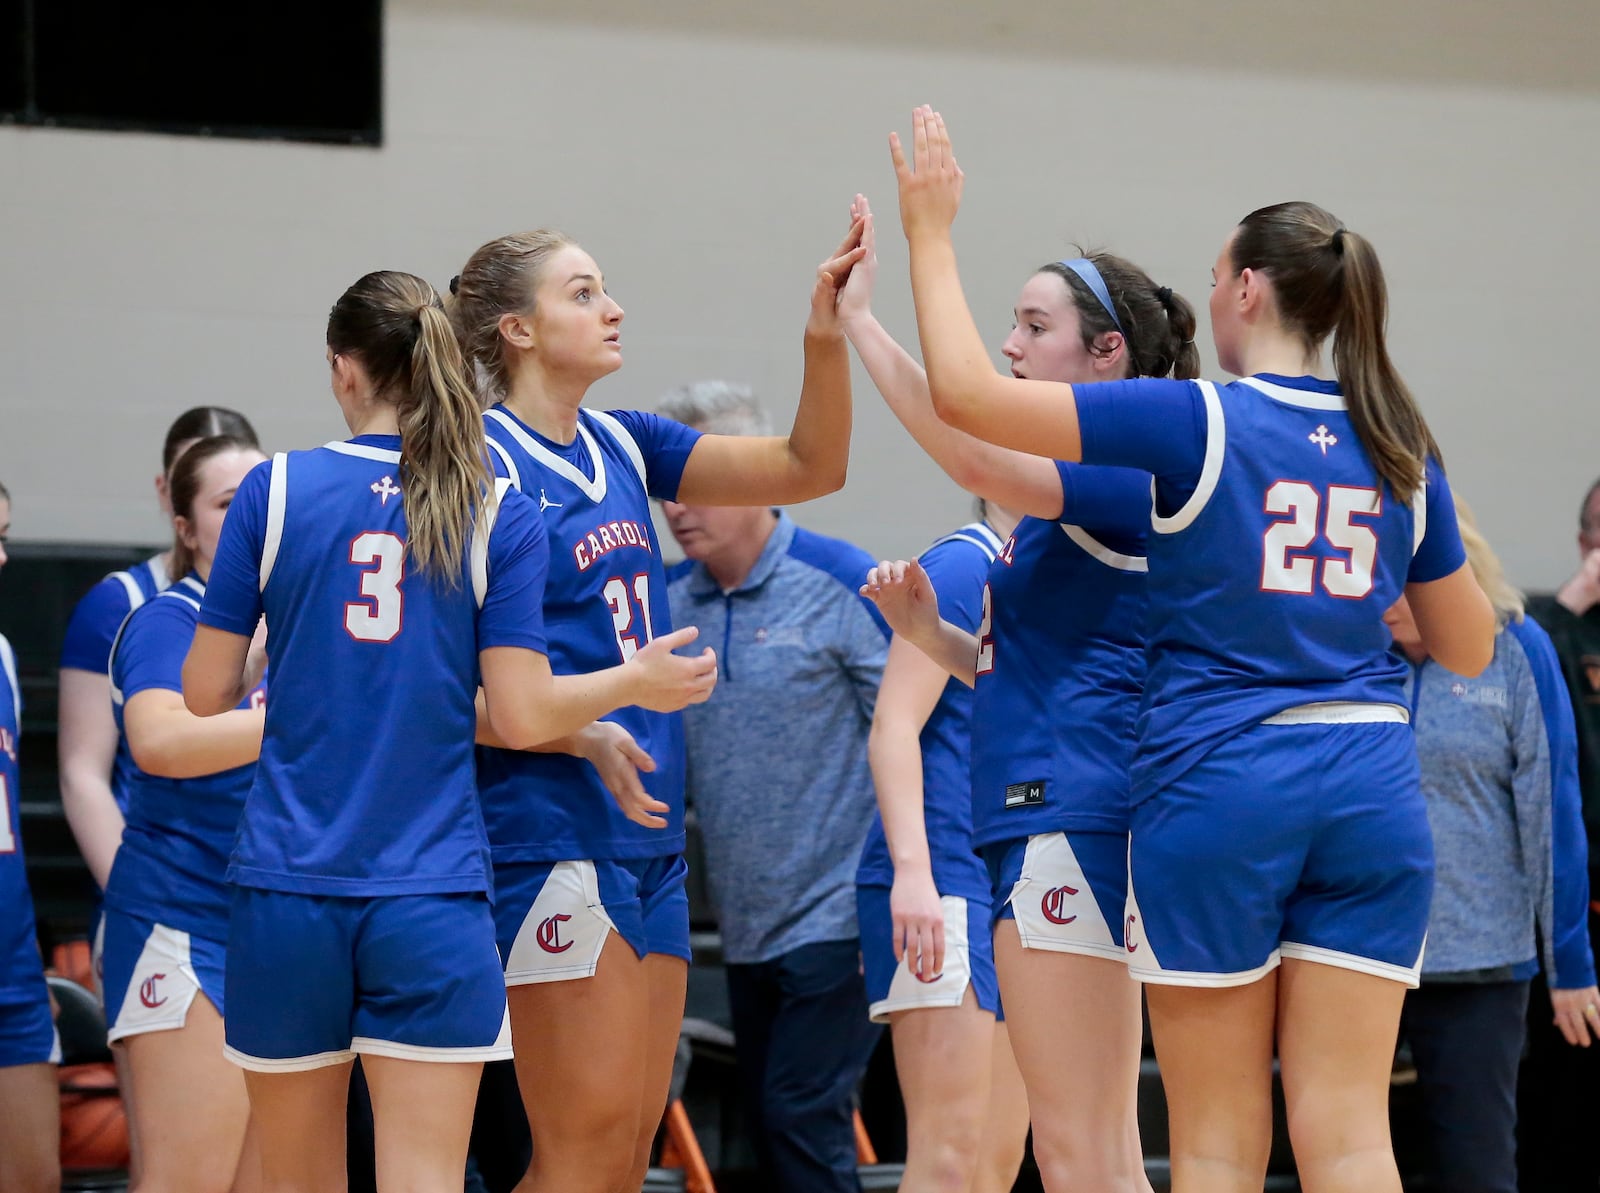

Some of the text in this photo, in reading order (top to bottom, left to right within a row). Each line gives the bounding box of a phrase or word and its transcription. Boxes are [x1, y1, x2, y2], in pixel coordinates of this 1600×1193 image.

[1260, 479, 1382, 600] 25
[343, 530, 405, 643] 3
[603, 572, 654, 665] 21
[1030, 788, 1039, 798] M
[1041, 885, 1079, 925] C
[536, 913, 574, 953] C
[140, 973, 168, 1009] C
